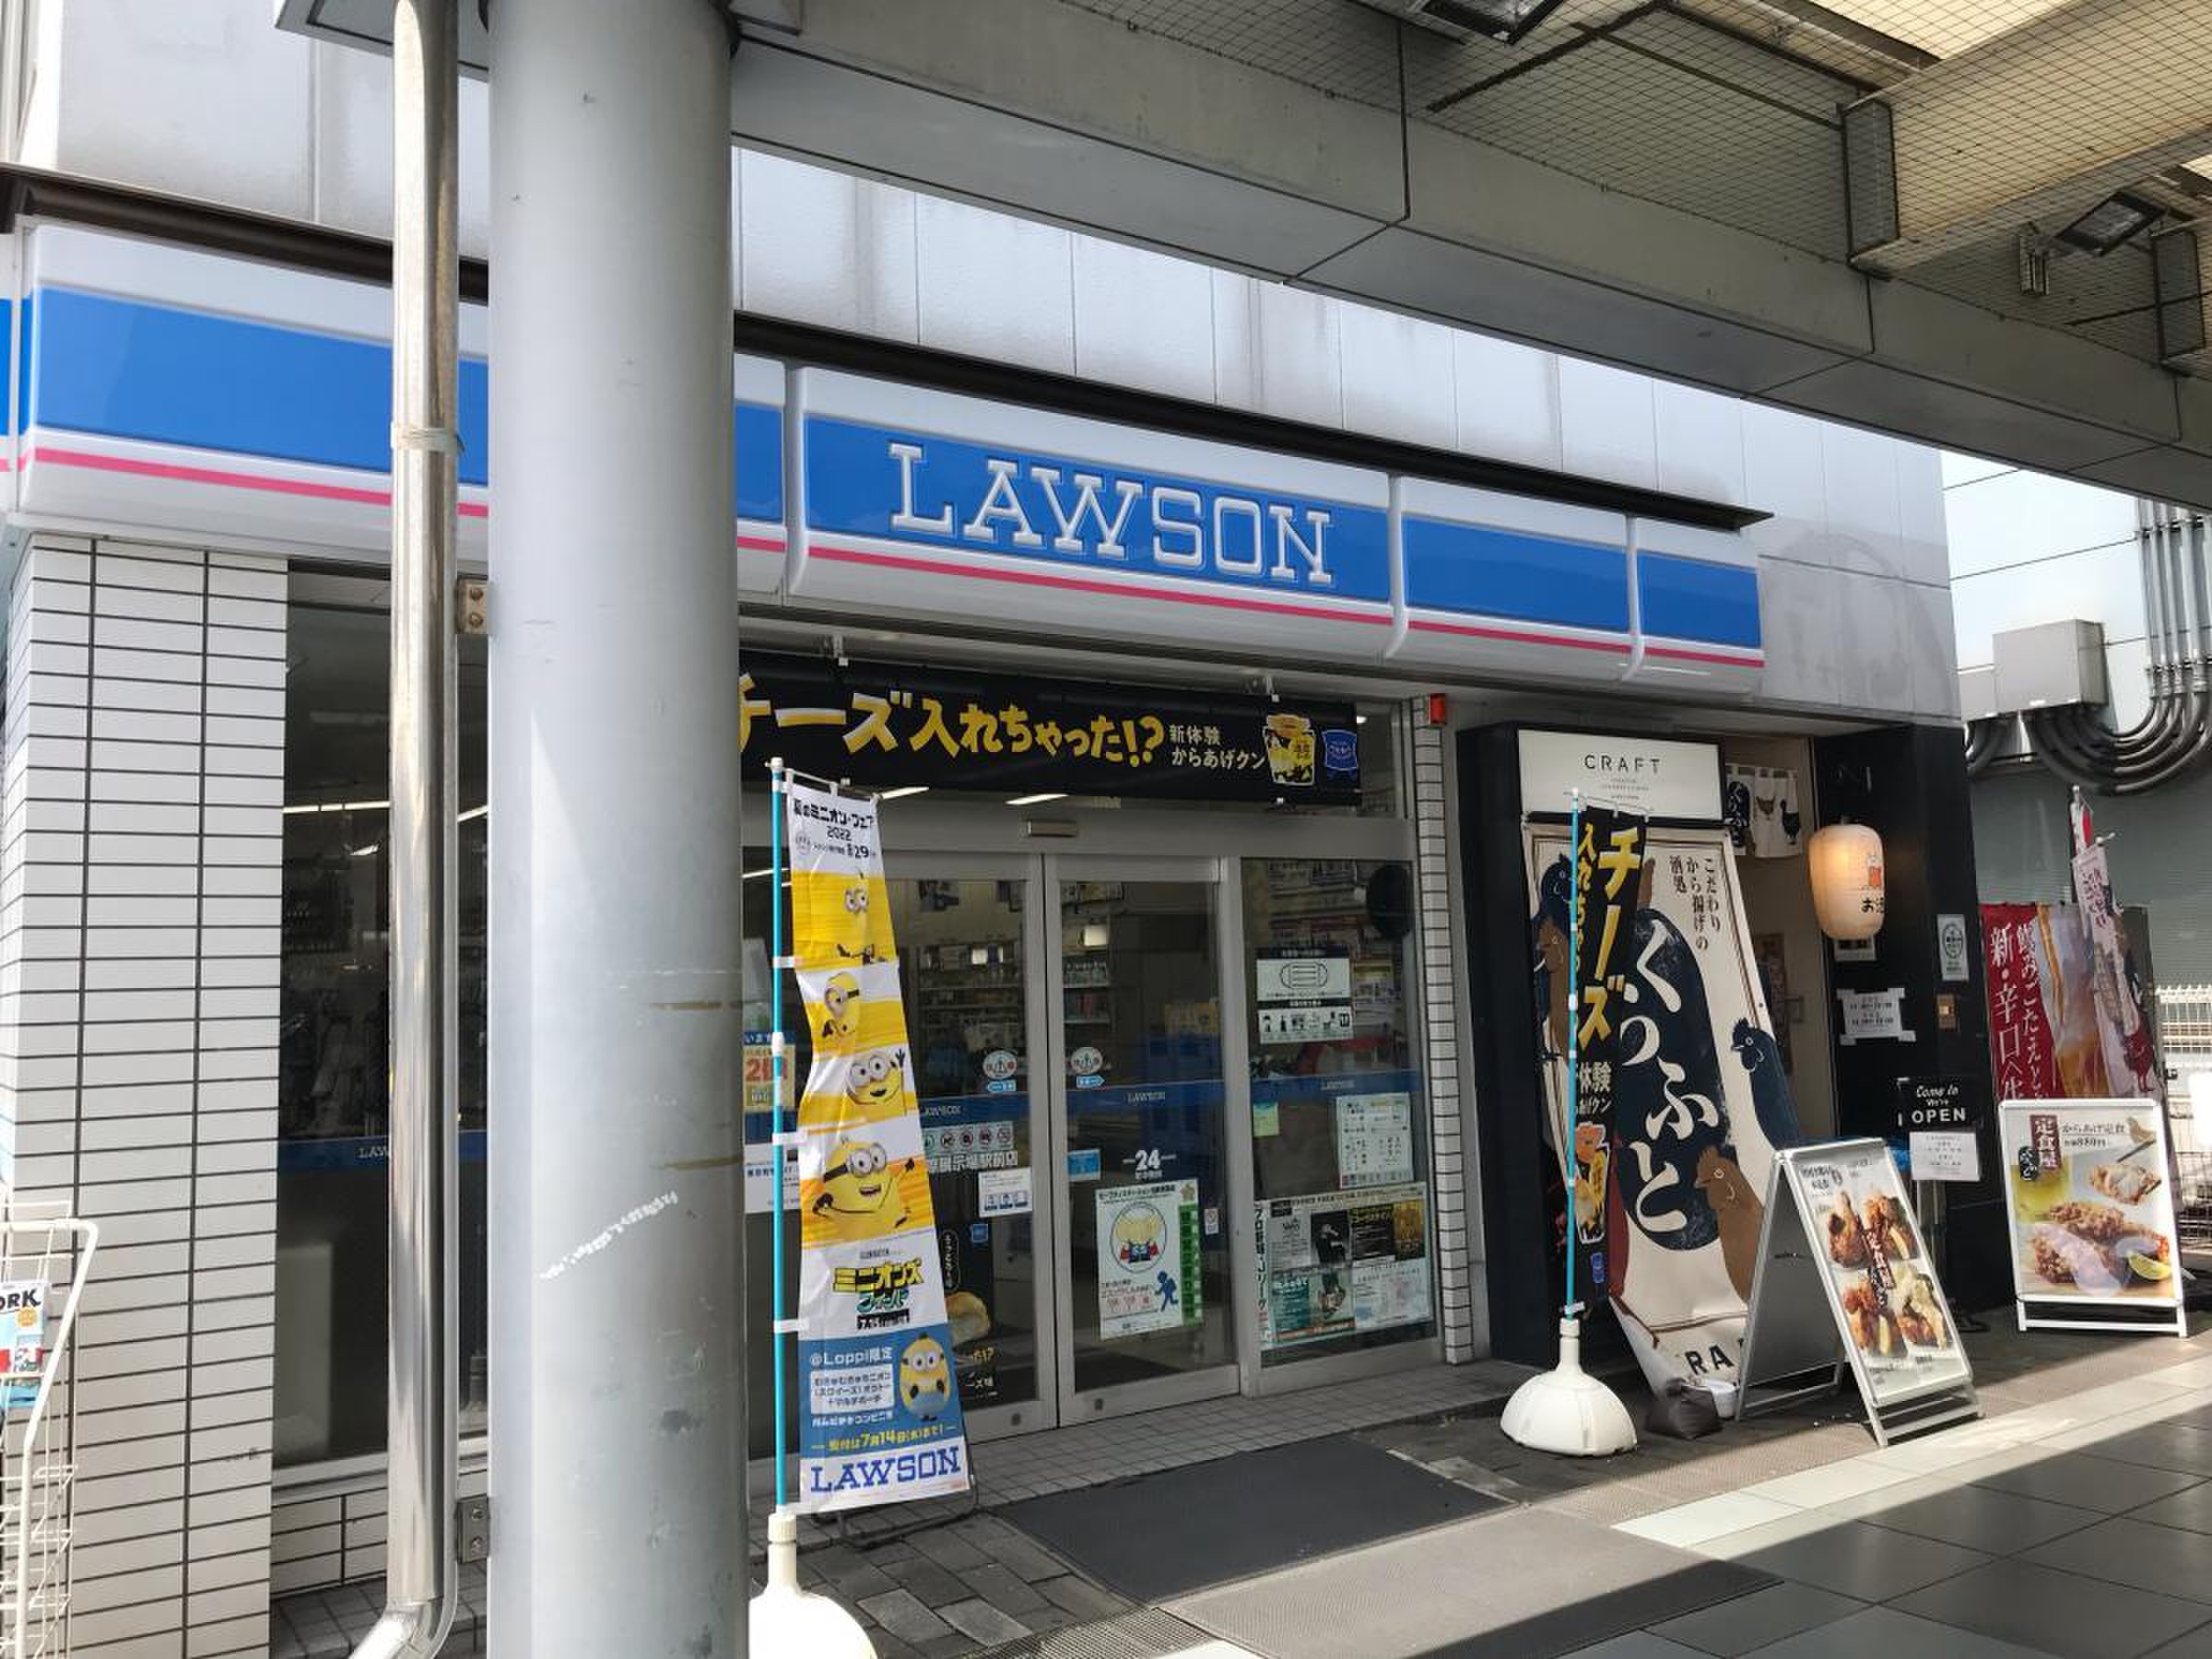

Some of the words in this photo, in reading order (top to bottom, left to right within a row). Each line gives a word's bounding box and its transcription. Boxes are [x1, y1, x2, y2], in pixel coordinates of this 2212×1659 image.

[888, 441, 1333, 585] LAWSON
[1169, 724, 1221, 747] 新体験
[1171, 747, 1266, 771] からあげクン
[1583, 754, 1661, 774] CRAFT
[1578, 827, 1641, 1052] チーズ
[1577, 1062, 1611, 1091] 体験
[1911, 1107, 1967, 1124] OPEN
[1135, 1150, 1160, 1171] 24
[833, 1257, 924, 1293] ミニオンズ
[810, 1445, 960, 1492] LAWSON
